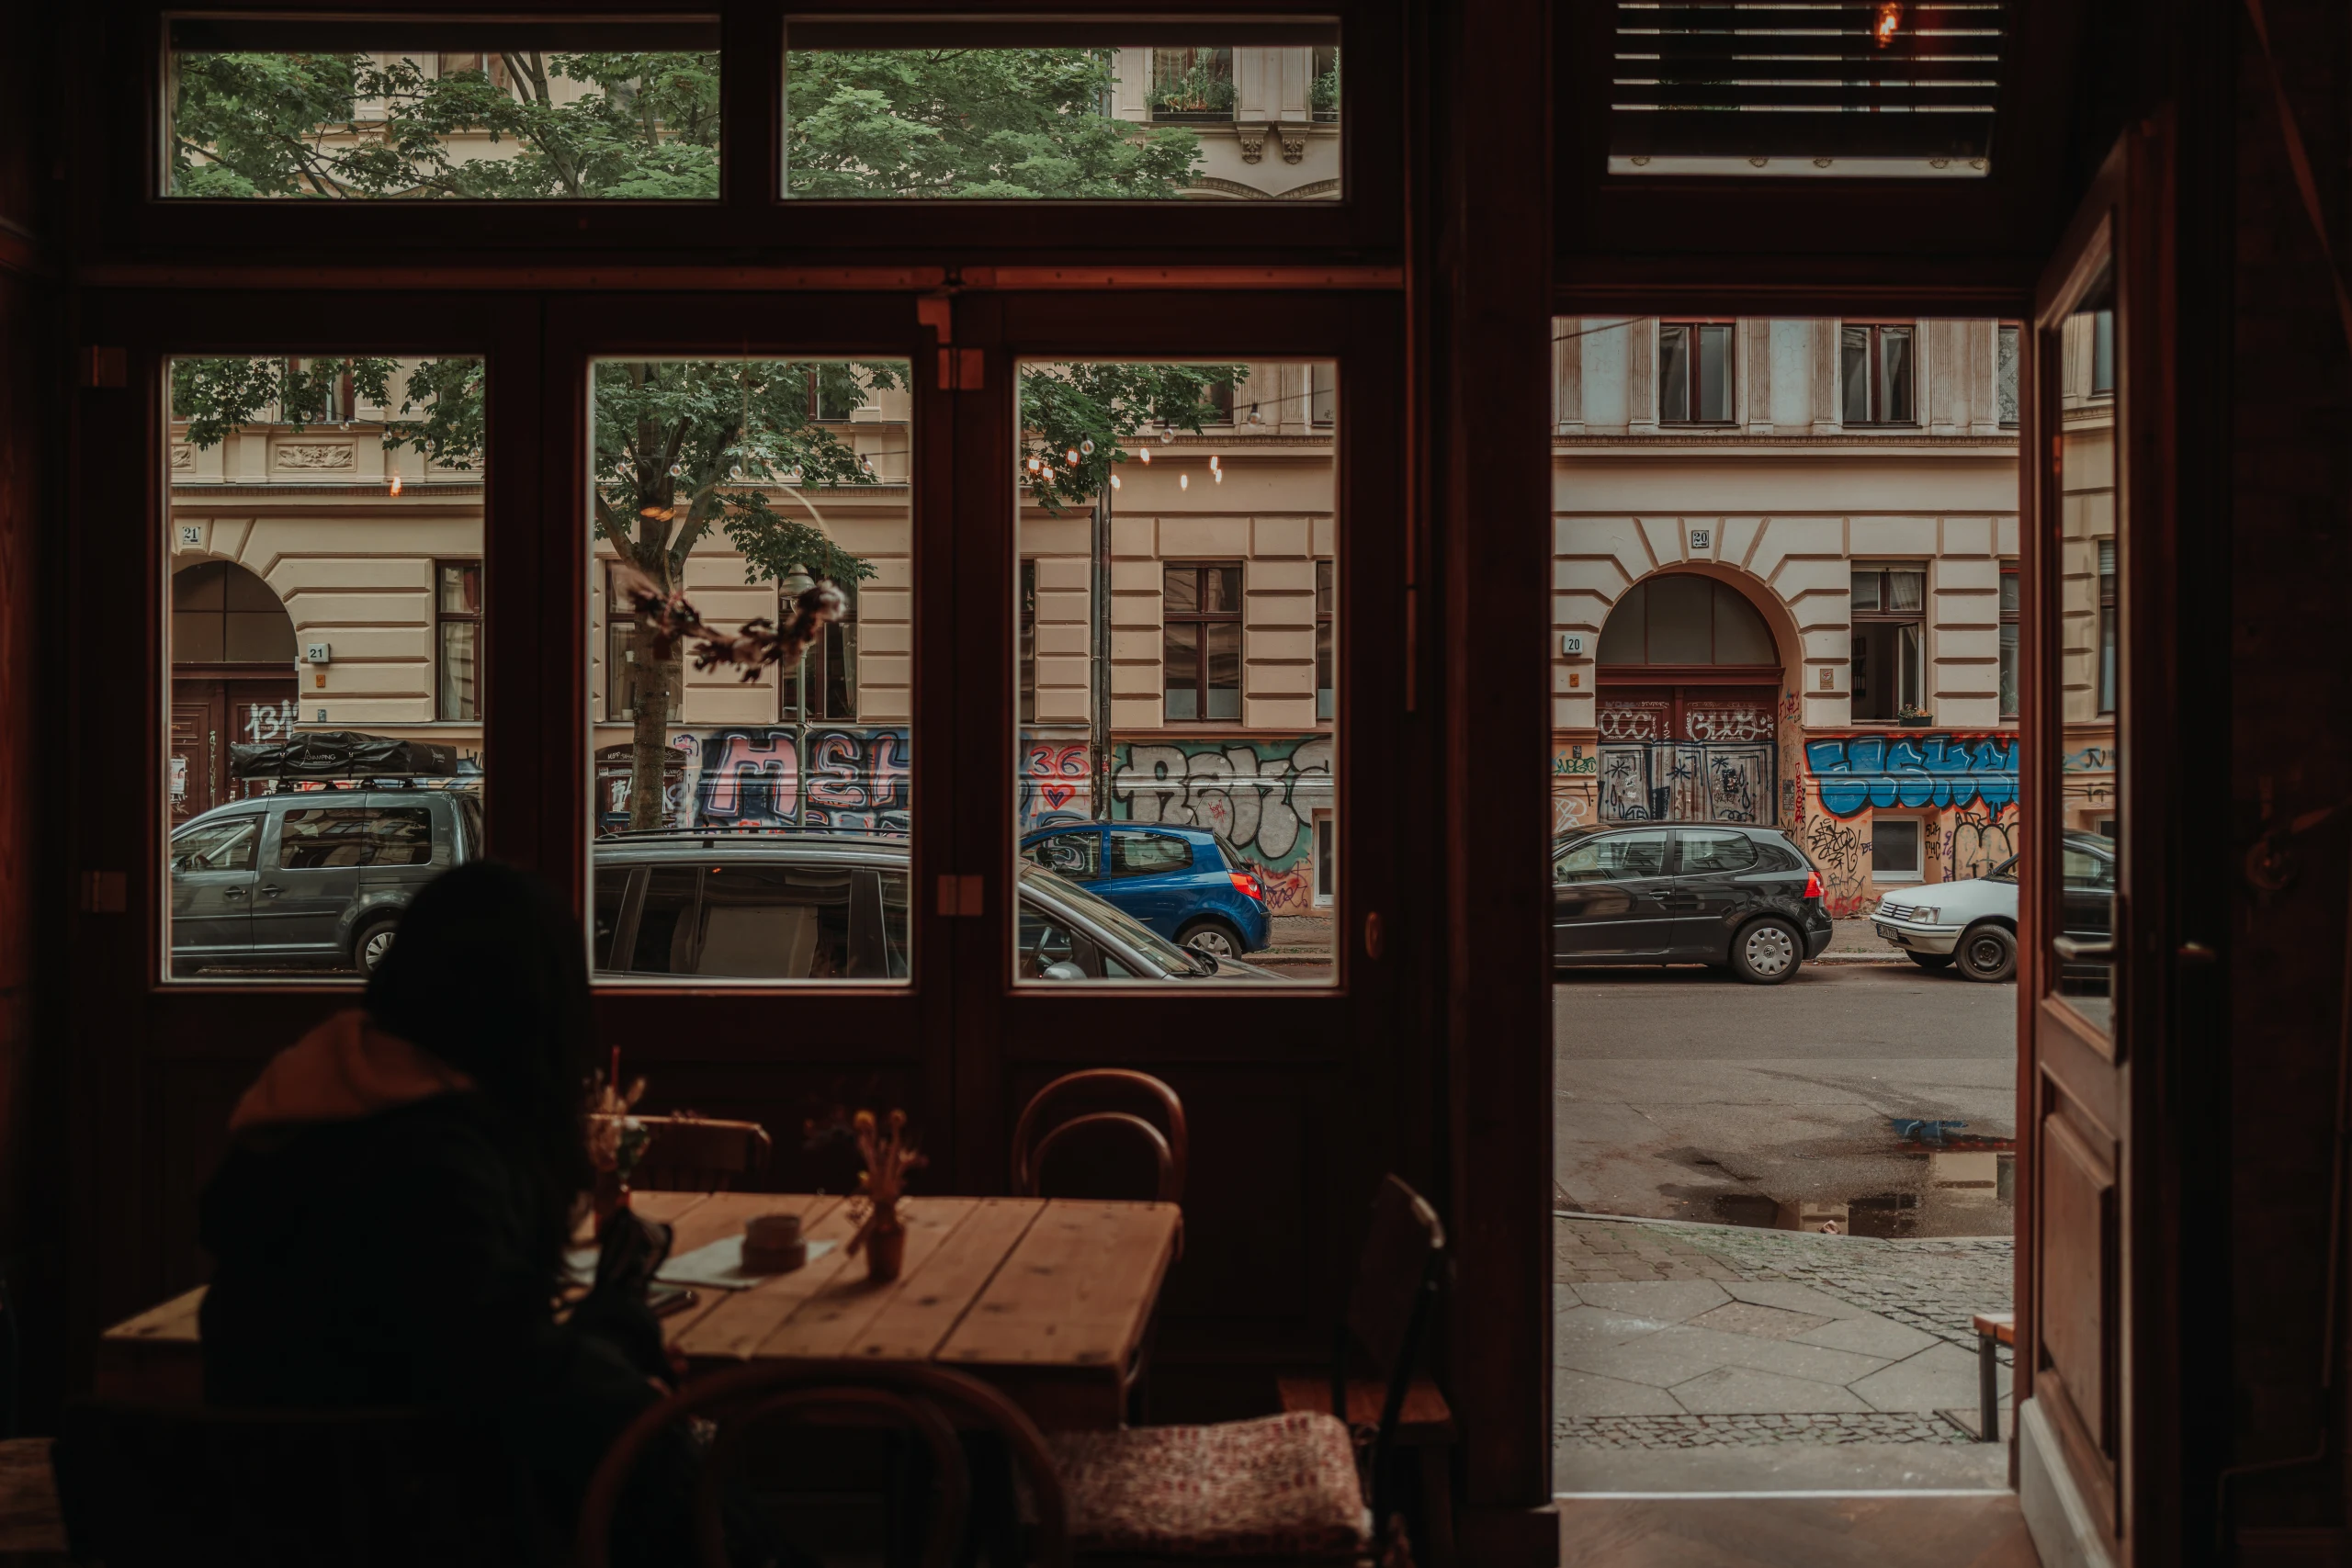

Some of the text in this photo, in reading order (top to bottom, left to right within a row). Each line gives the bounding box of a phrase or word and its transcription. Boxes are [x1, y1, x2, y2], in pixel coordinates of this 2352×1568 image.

[184, 527, 198, 539] 21
[1693, 532, 1707, 543] 20
[1568, 638, 1580, 650] 20
[310, 649, 323, 659] 21
[1029, 745, 1091, 781] 36
